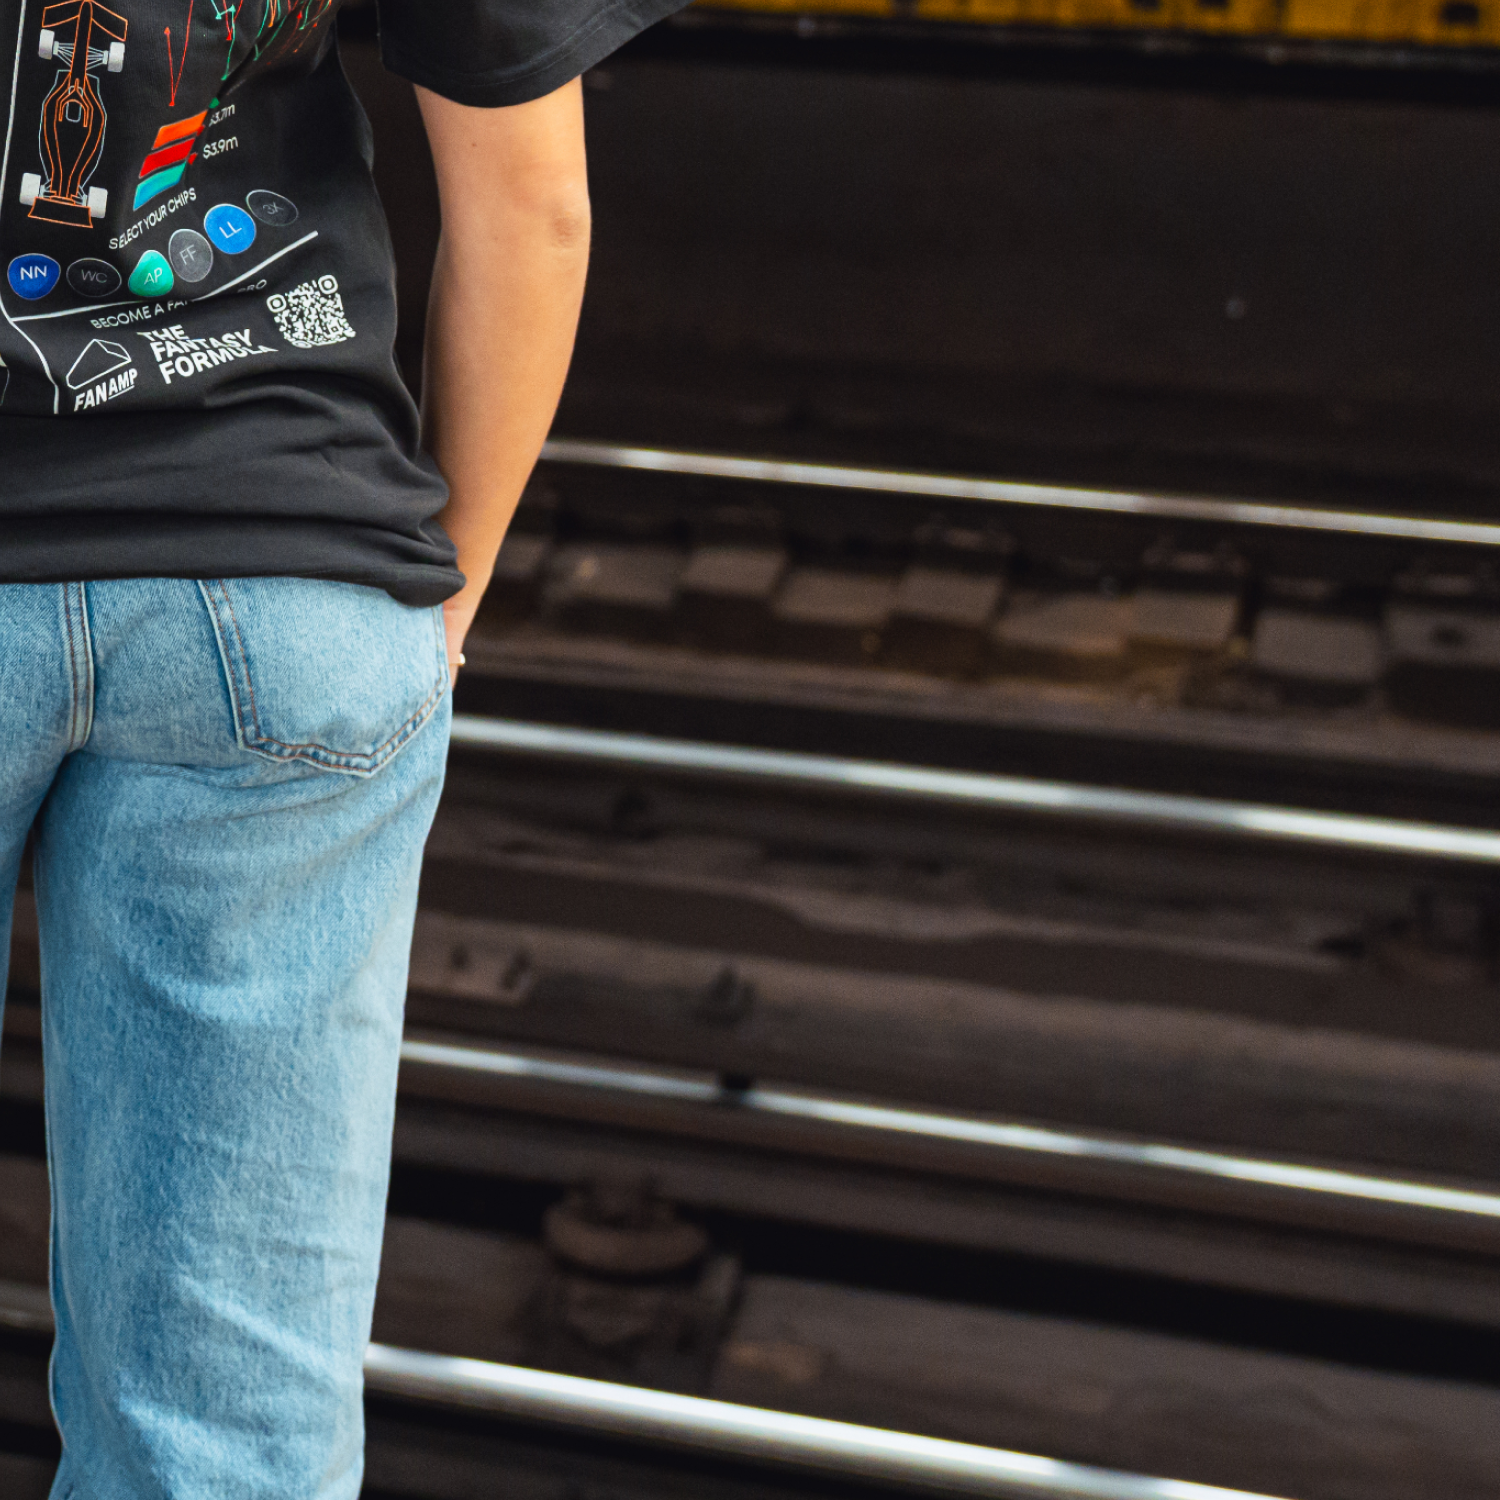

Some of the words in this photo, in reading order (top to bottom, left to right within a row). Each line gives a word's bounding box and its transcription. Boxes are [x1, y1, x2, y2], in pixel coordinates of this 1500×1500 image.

[108, 220, 143, 250] SELECT
[142, 204, 168, 230] YOUR
[167, 187, 197, 213] CHIPS
[218, 220, 243, 239] LL
[179, 244, 197, 265] FF
[20, 265, 48, 281] NN
[80, 269, 108, 284] WC
[143, 267, 163, 285] AP
[90, 305, 152, 329] BECOME
[154, 305, 165, 316] A
[137, 324, 190, 342] THE
[150, 328, 253, 362] FANTASY
[74, 368, 138, 412] FANAMP
